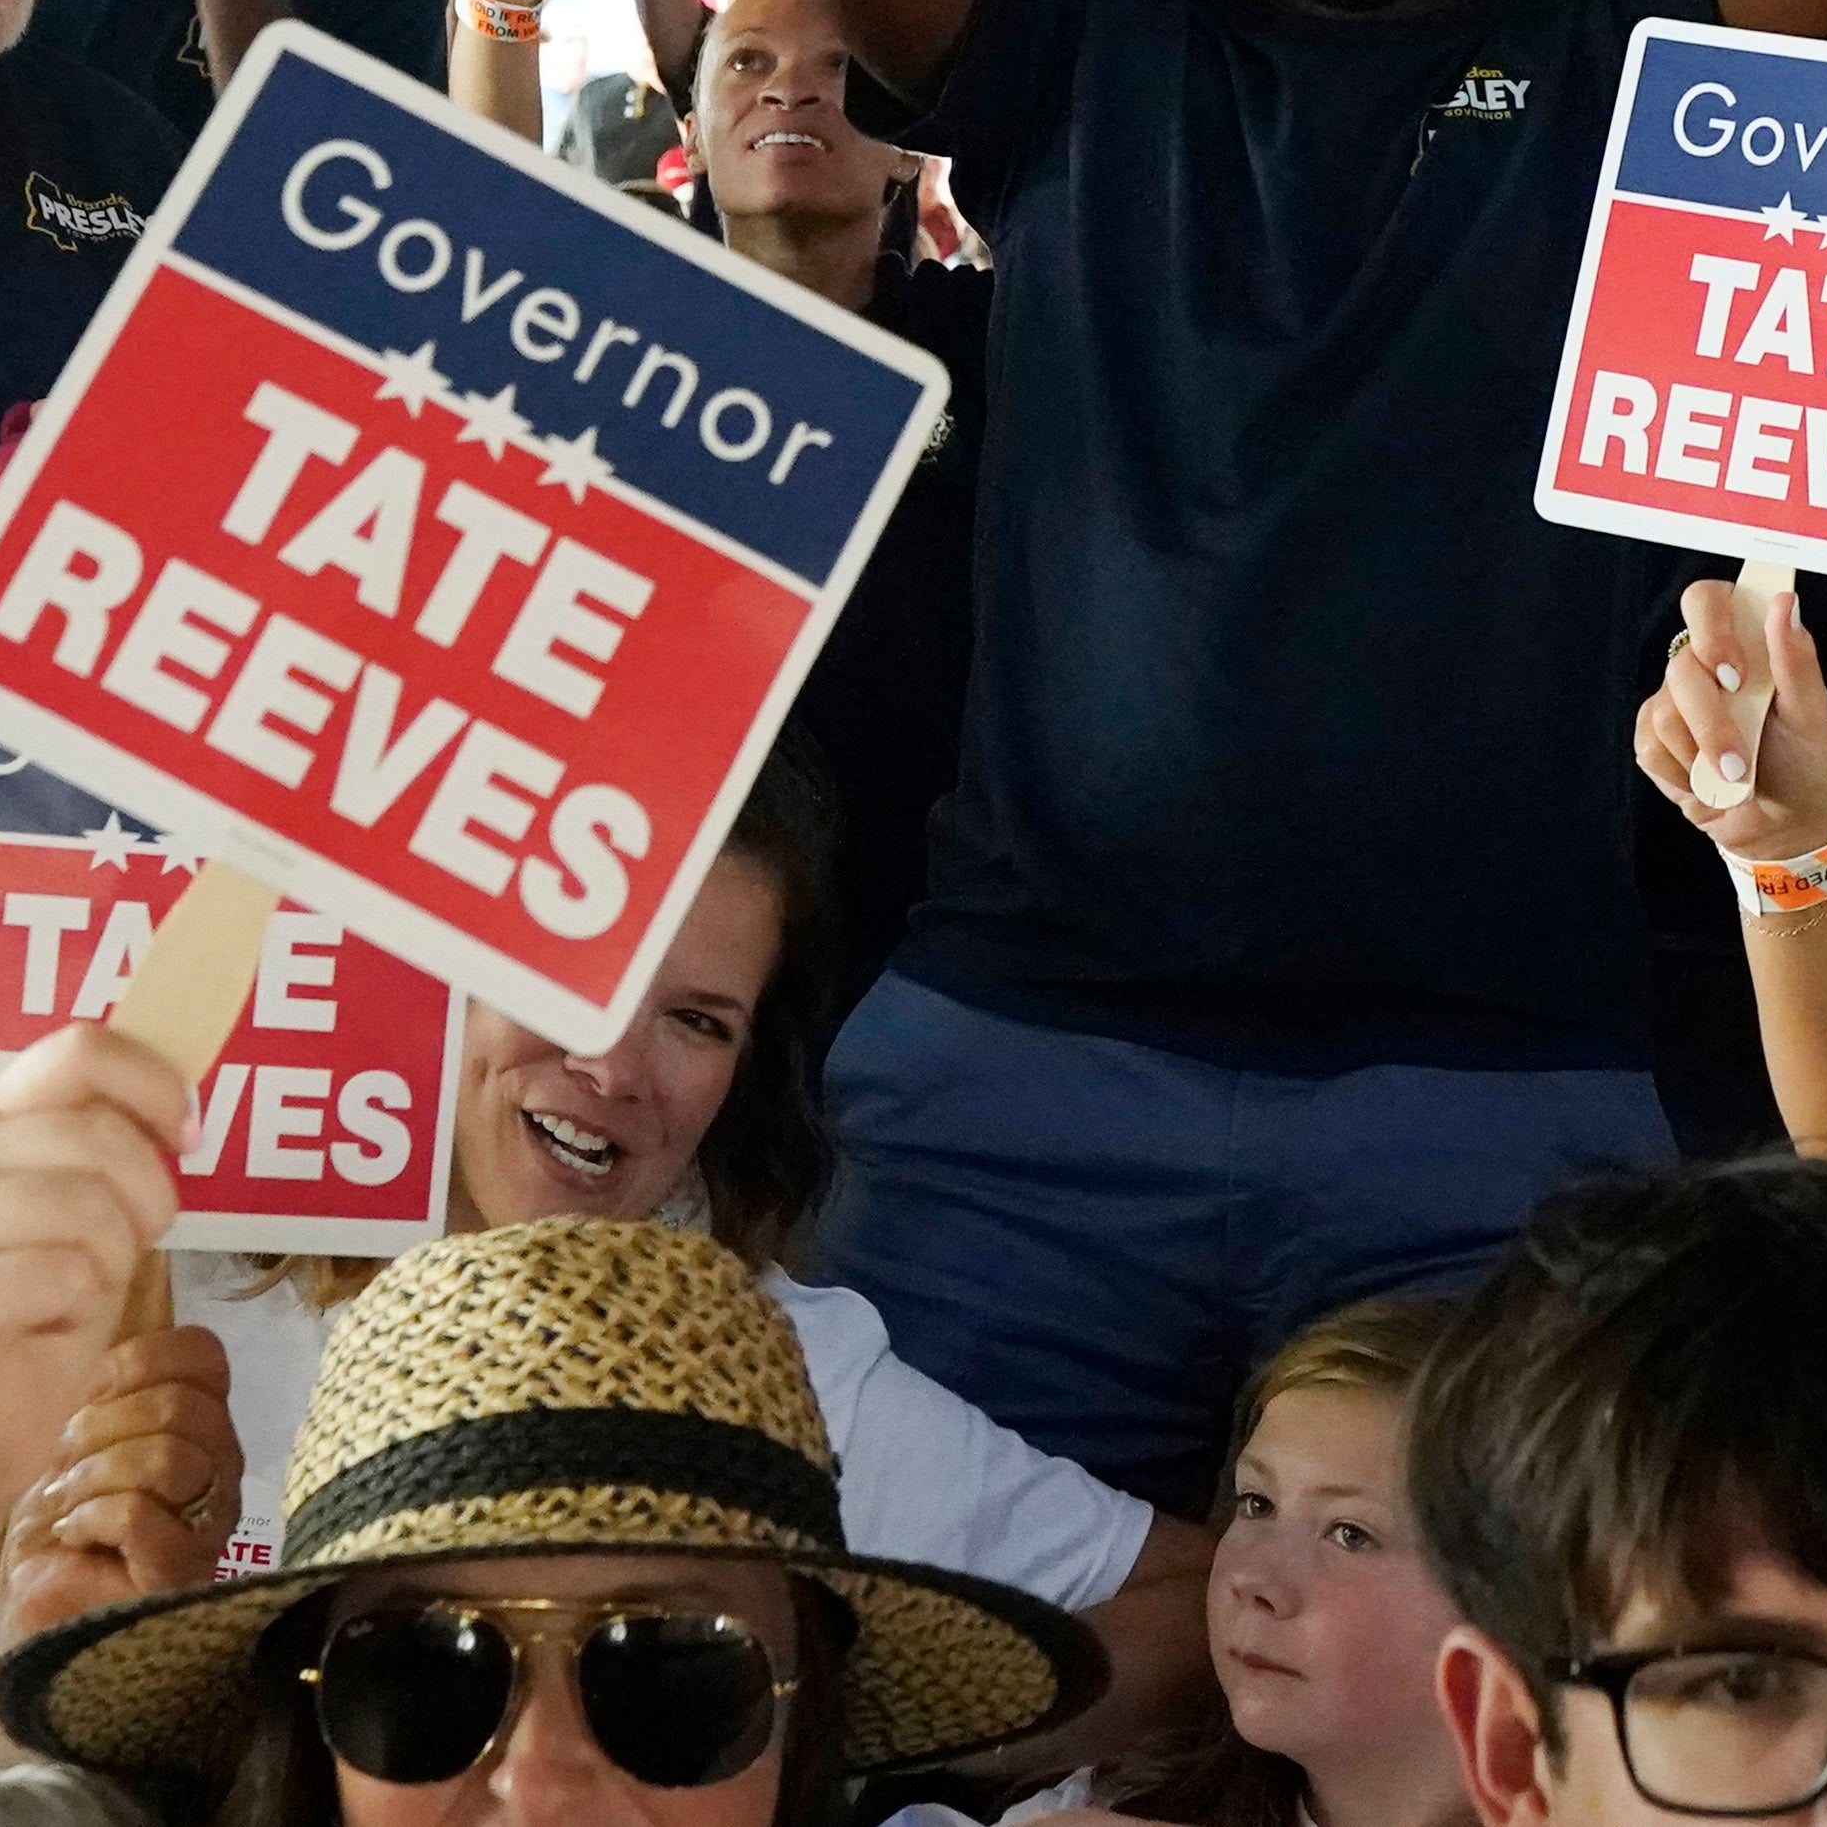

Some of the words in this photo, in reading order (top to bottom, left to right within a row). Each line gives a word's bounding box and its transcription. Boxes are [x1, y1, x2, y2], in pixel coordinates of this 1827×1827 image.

[477, 18, 519, 38] FROM
[278, 137, 835, 488] Governor
[220, 378, 657, 720] TATE
[1762, 879, 1789, 896] FR
[2, 891, 345, 1034] TAE
